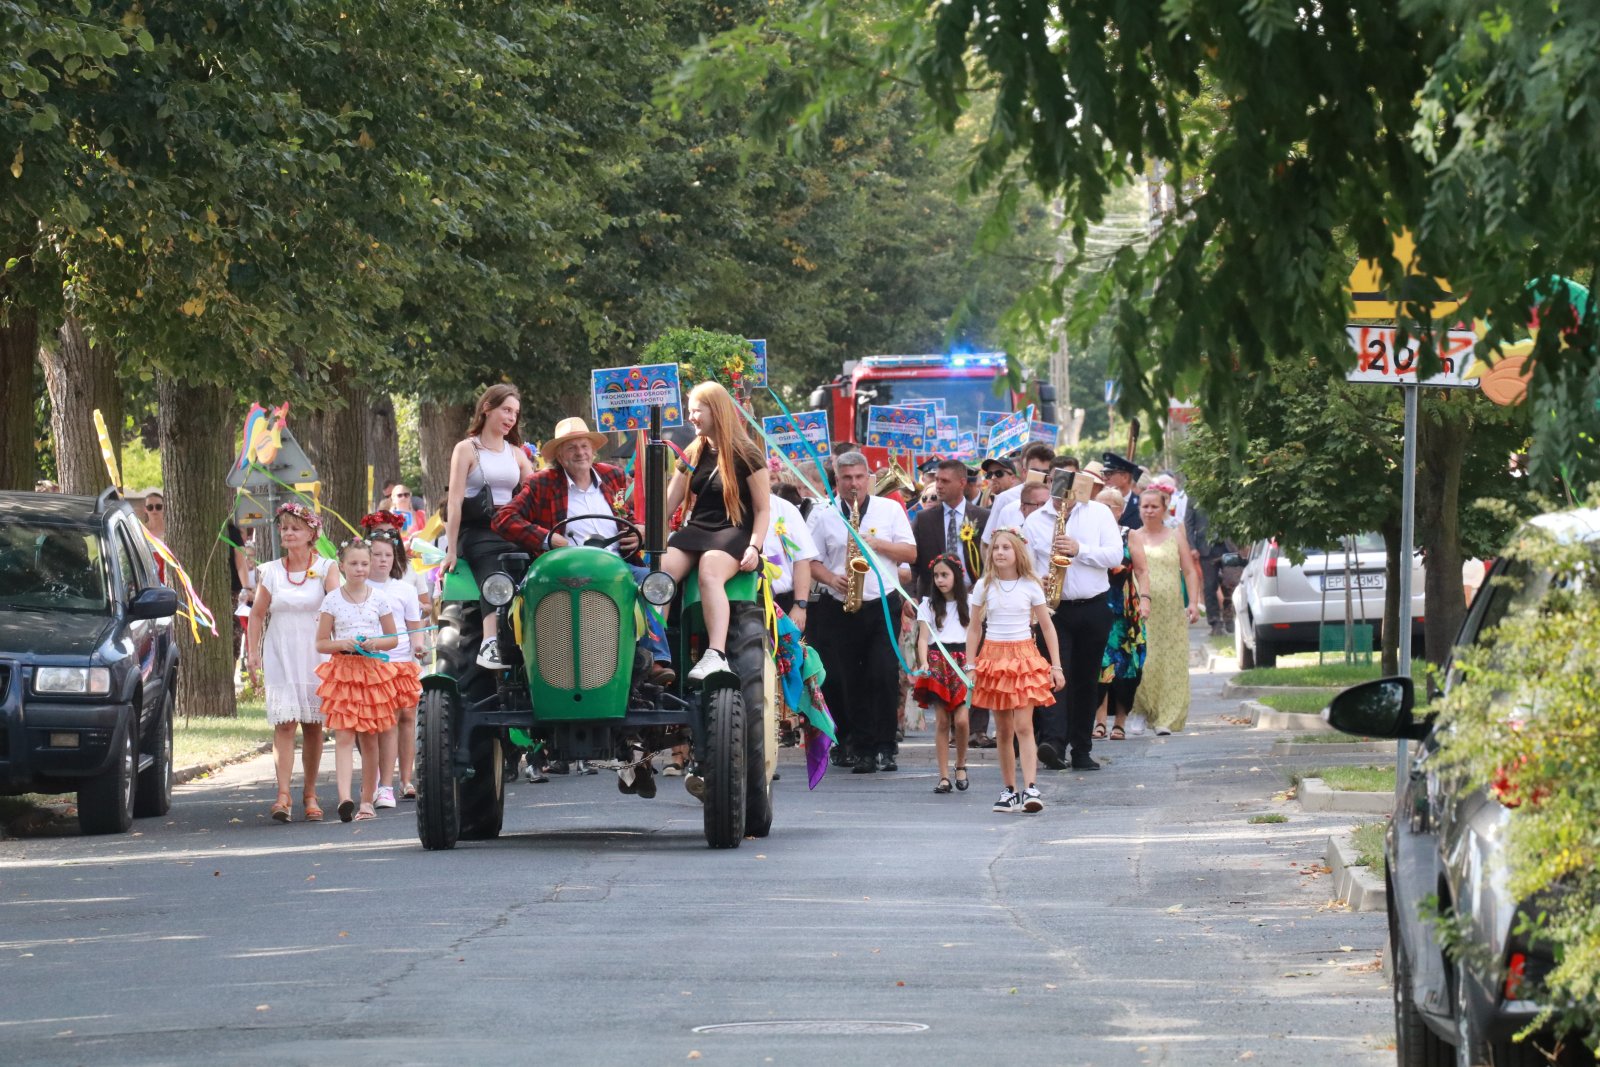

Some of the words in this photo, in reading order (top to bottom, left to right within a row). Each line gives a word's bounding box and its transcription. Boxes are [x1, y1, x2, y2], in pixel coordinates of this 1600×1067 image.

[1367, 340, 1414, 371] 20
[601, 392, 643, 401] PROCHOWICKI
[610, 398, 636, 406] KULTURY
[640, 397, 664, 405] SPORTU
